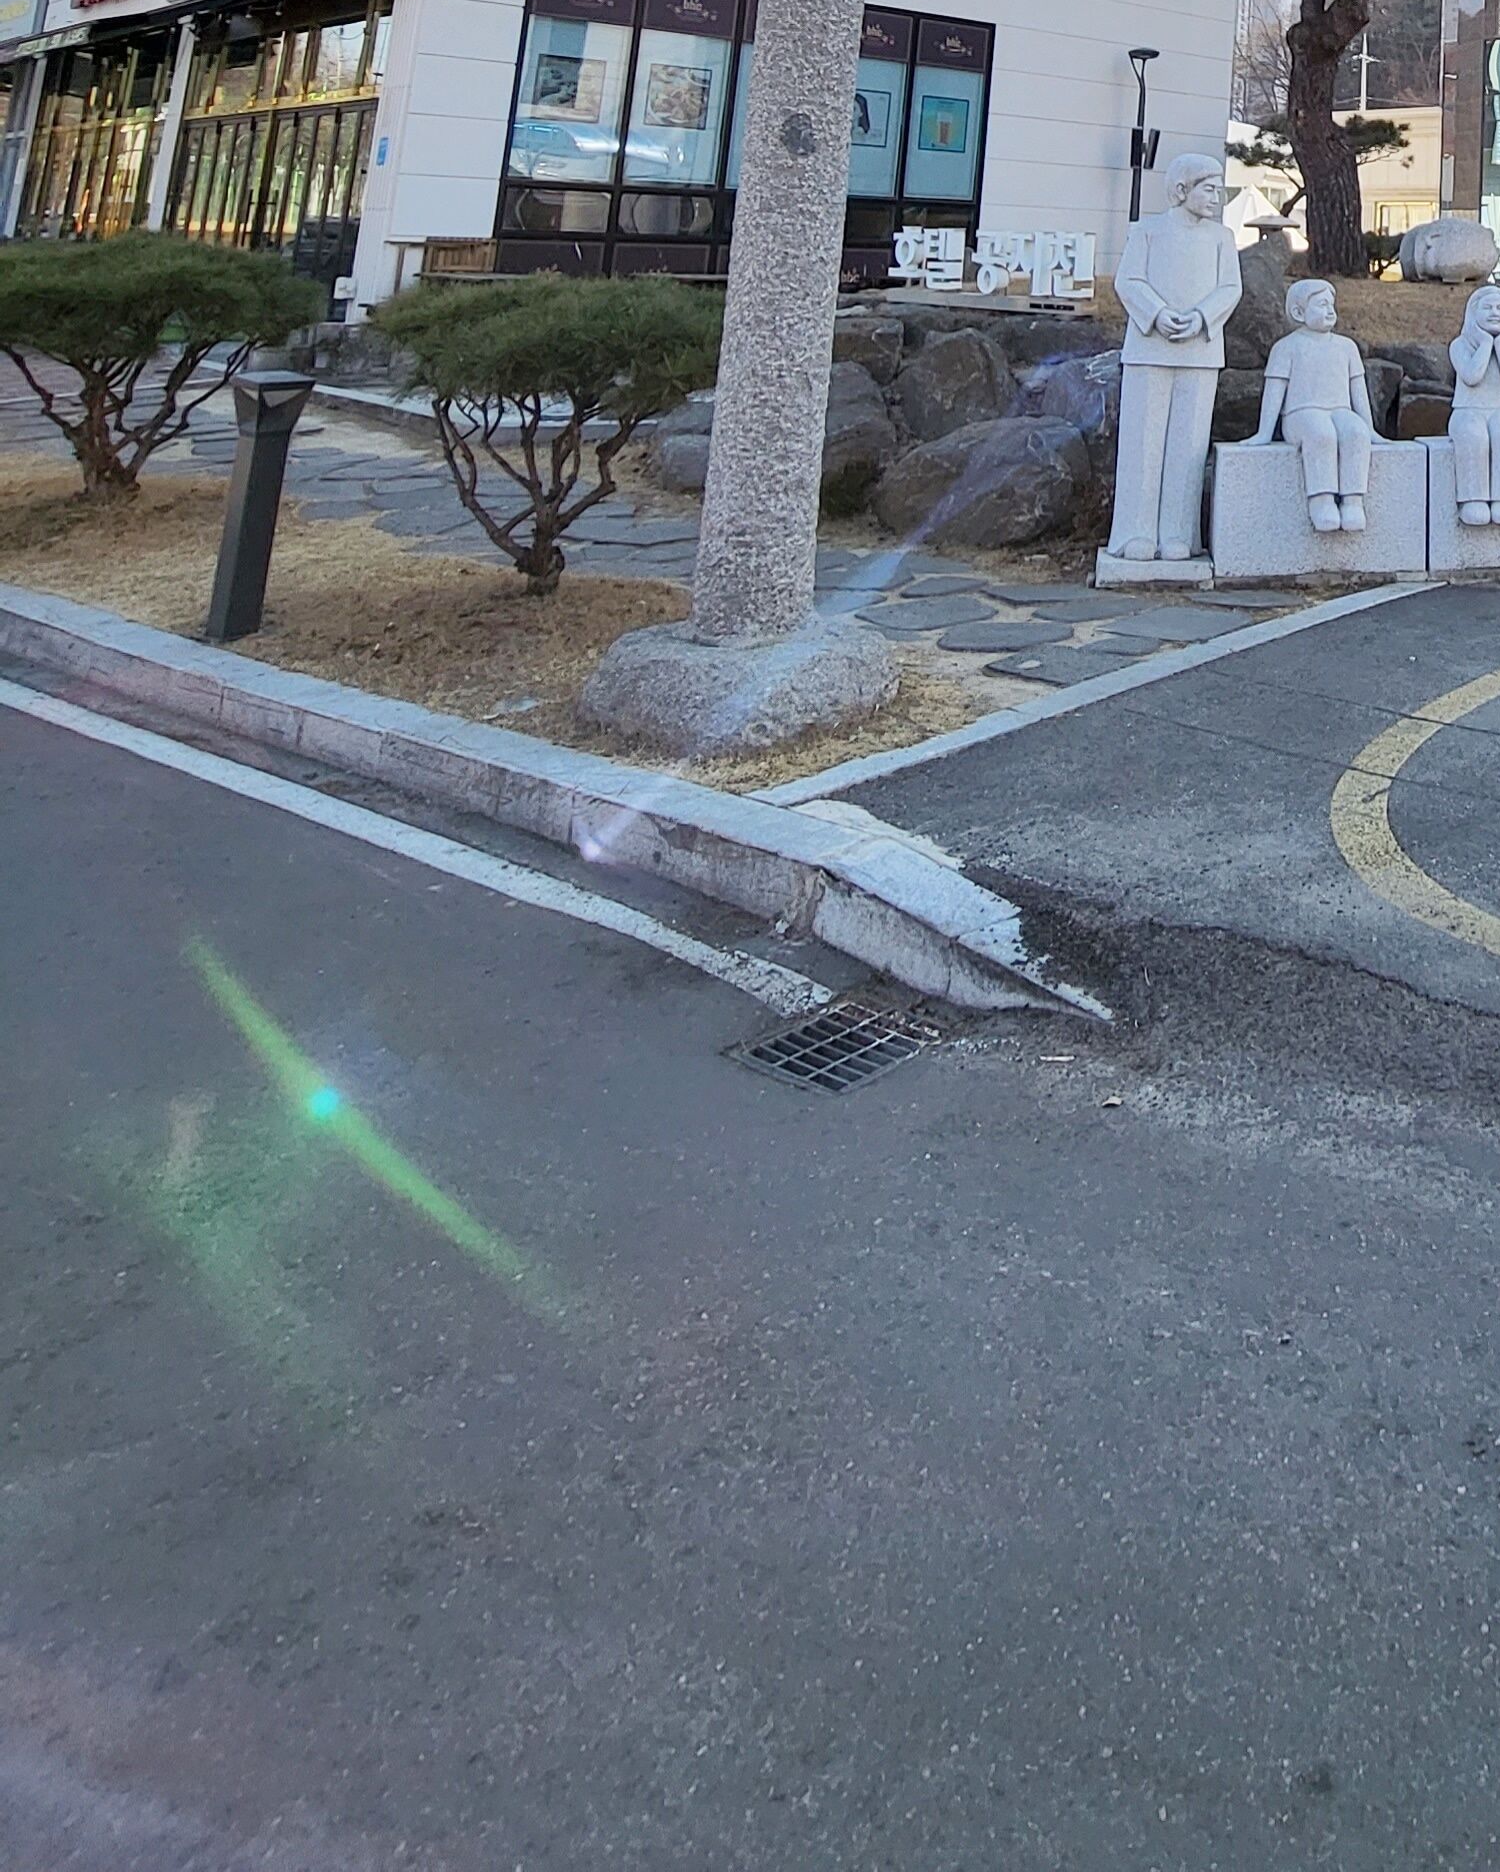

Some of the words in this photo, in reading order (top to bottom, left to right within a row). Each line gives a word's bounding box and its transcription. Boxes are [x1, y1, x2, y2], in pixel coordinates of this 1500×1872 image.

[683, 0, 703, 12] bhc
[888, 225, 966, 290] 호텔
[971, 229, 1096, 299] 공지천
